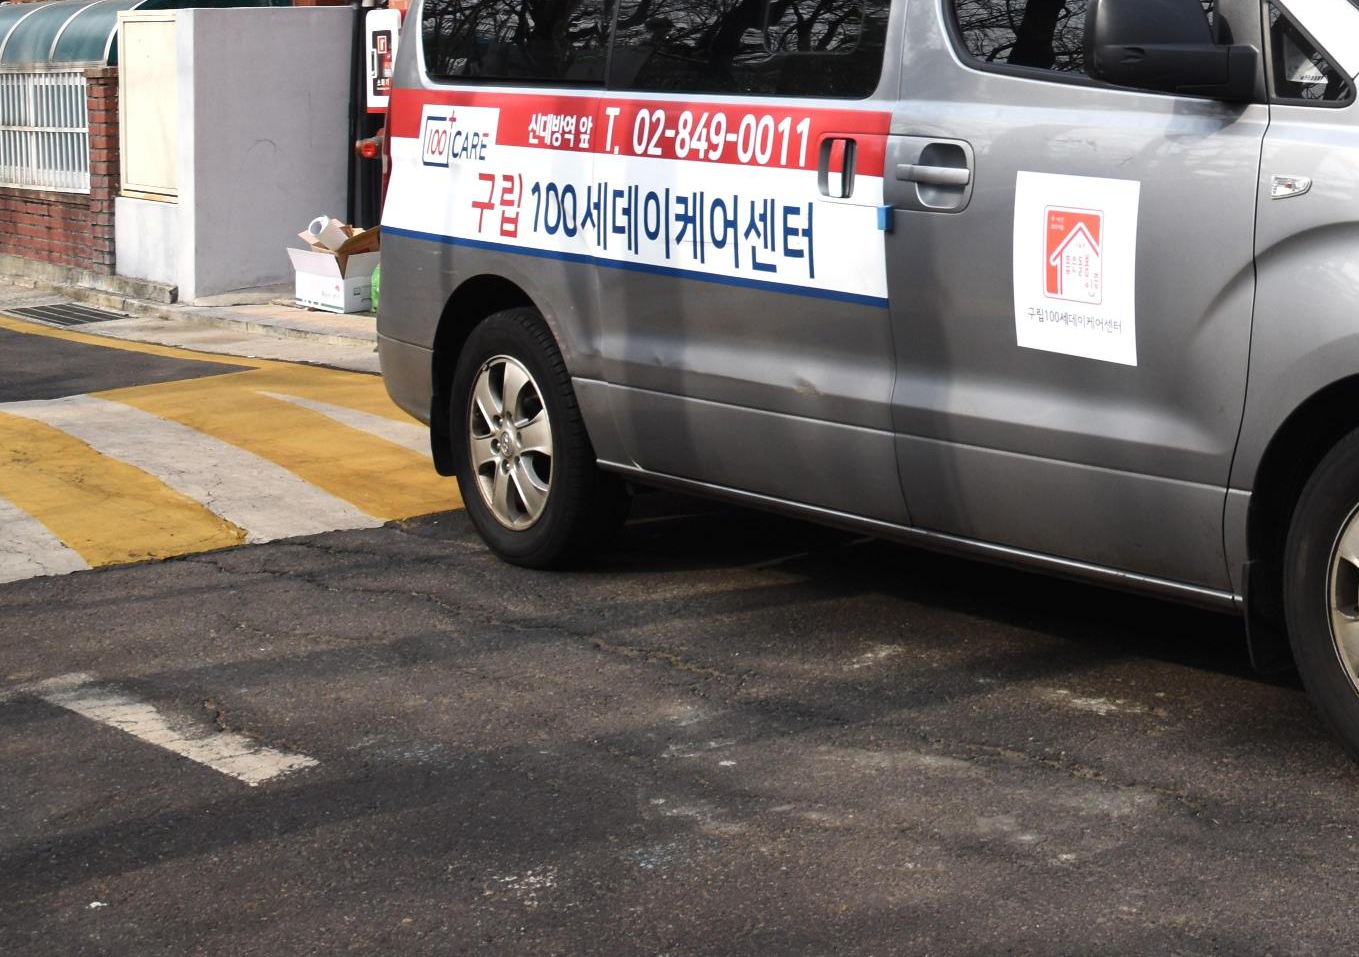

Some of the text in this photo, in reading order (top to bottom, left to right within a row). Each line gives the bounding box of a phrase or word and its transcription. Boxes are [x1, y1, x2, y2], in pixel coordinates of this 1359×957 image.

[426, 129, 489, 160] 100 CARE
[528, 107, 811, 167] 신대방역 앞 T. 02-849-0011
[471, 172, 815, 279] 구립 100세데이케어센터
[1027, 307, 1122, 333] 구립100세데이케어센터
